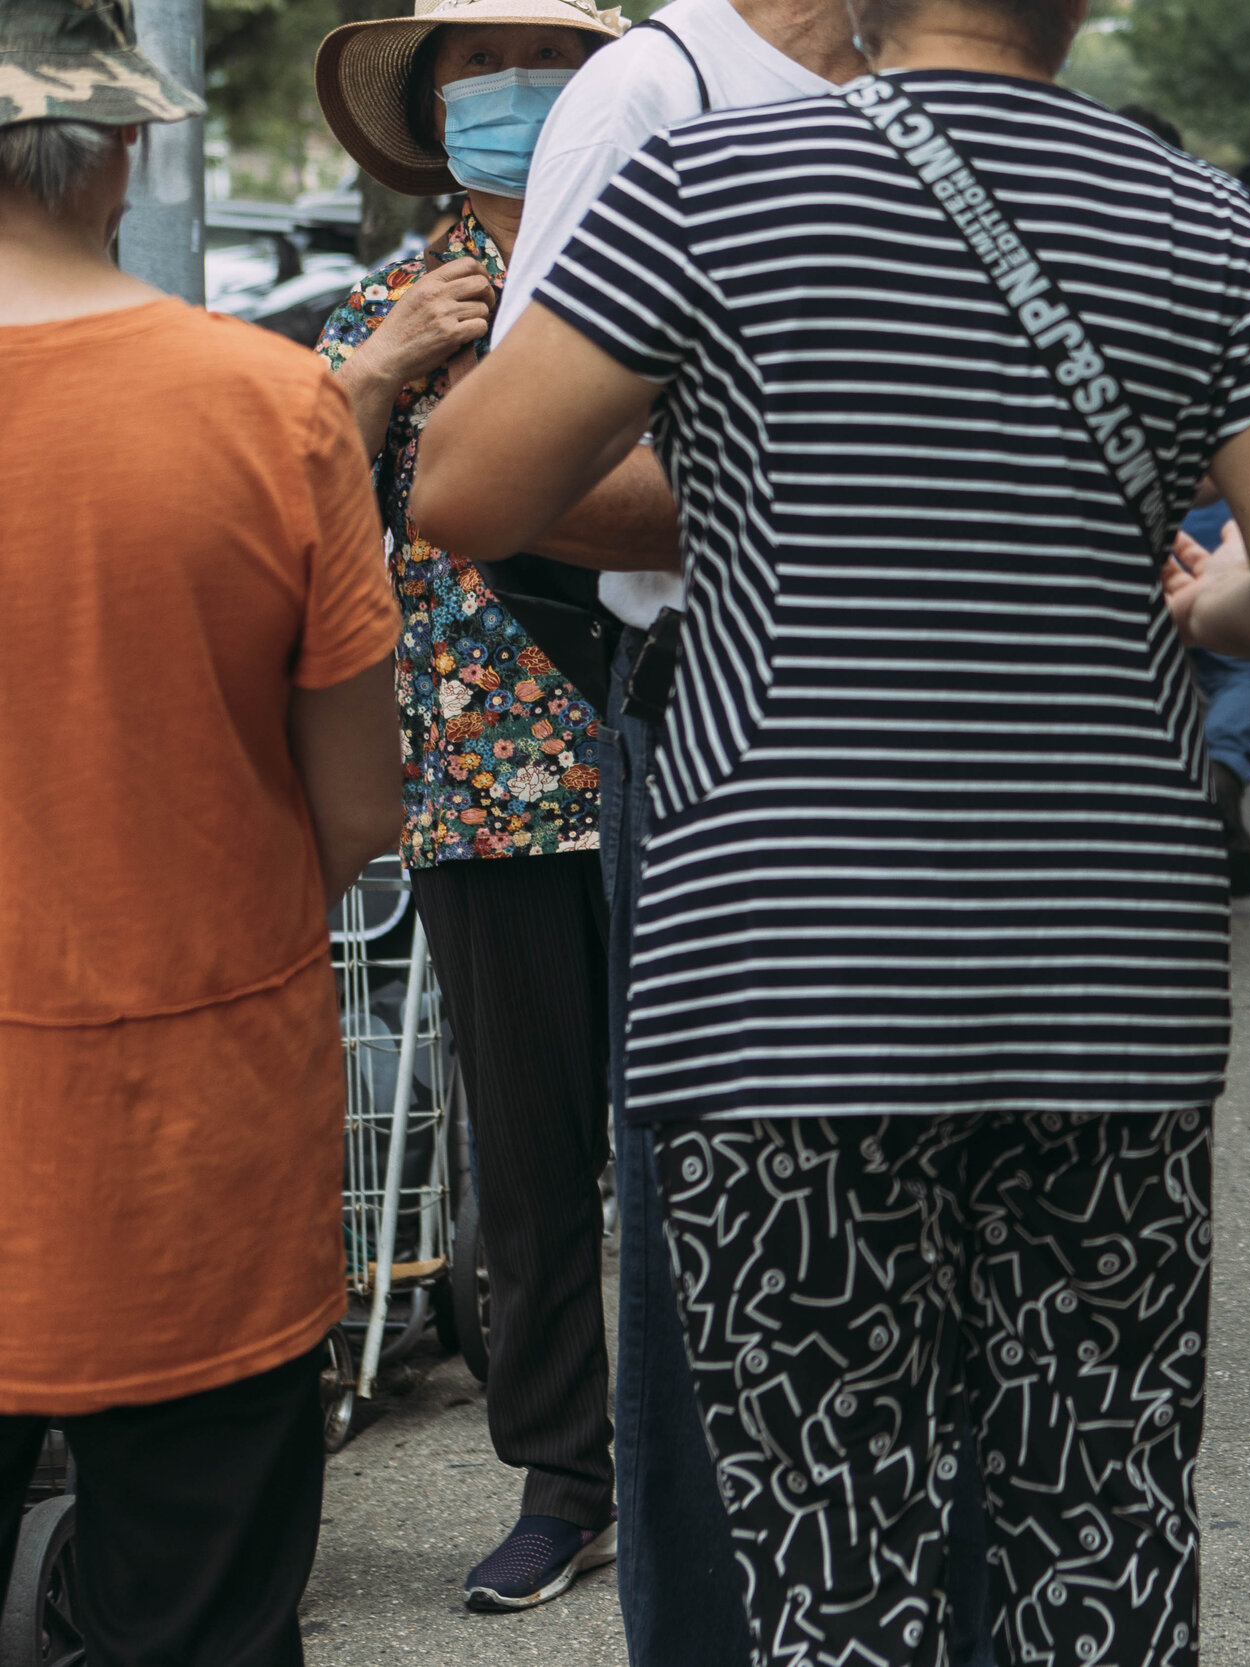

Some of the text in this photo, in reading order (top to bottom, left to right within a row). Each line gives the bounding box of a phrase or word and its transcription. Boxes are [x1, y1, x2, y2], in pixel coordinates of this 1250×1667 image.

[932, 179, 1010, 277] LIMITED
[950, 167, 1030, 267] EDITION
[996, 260, 1158, 498] MCYS&JPN
